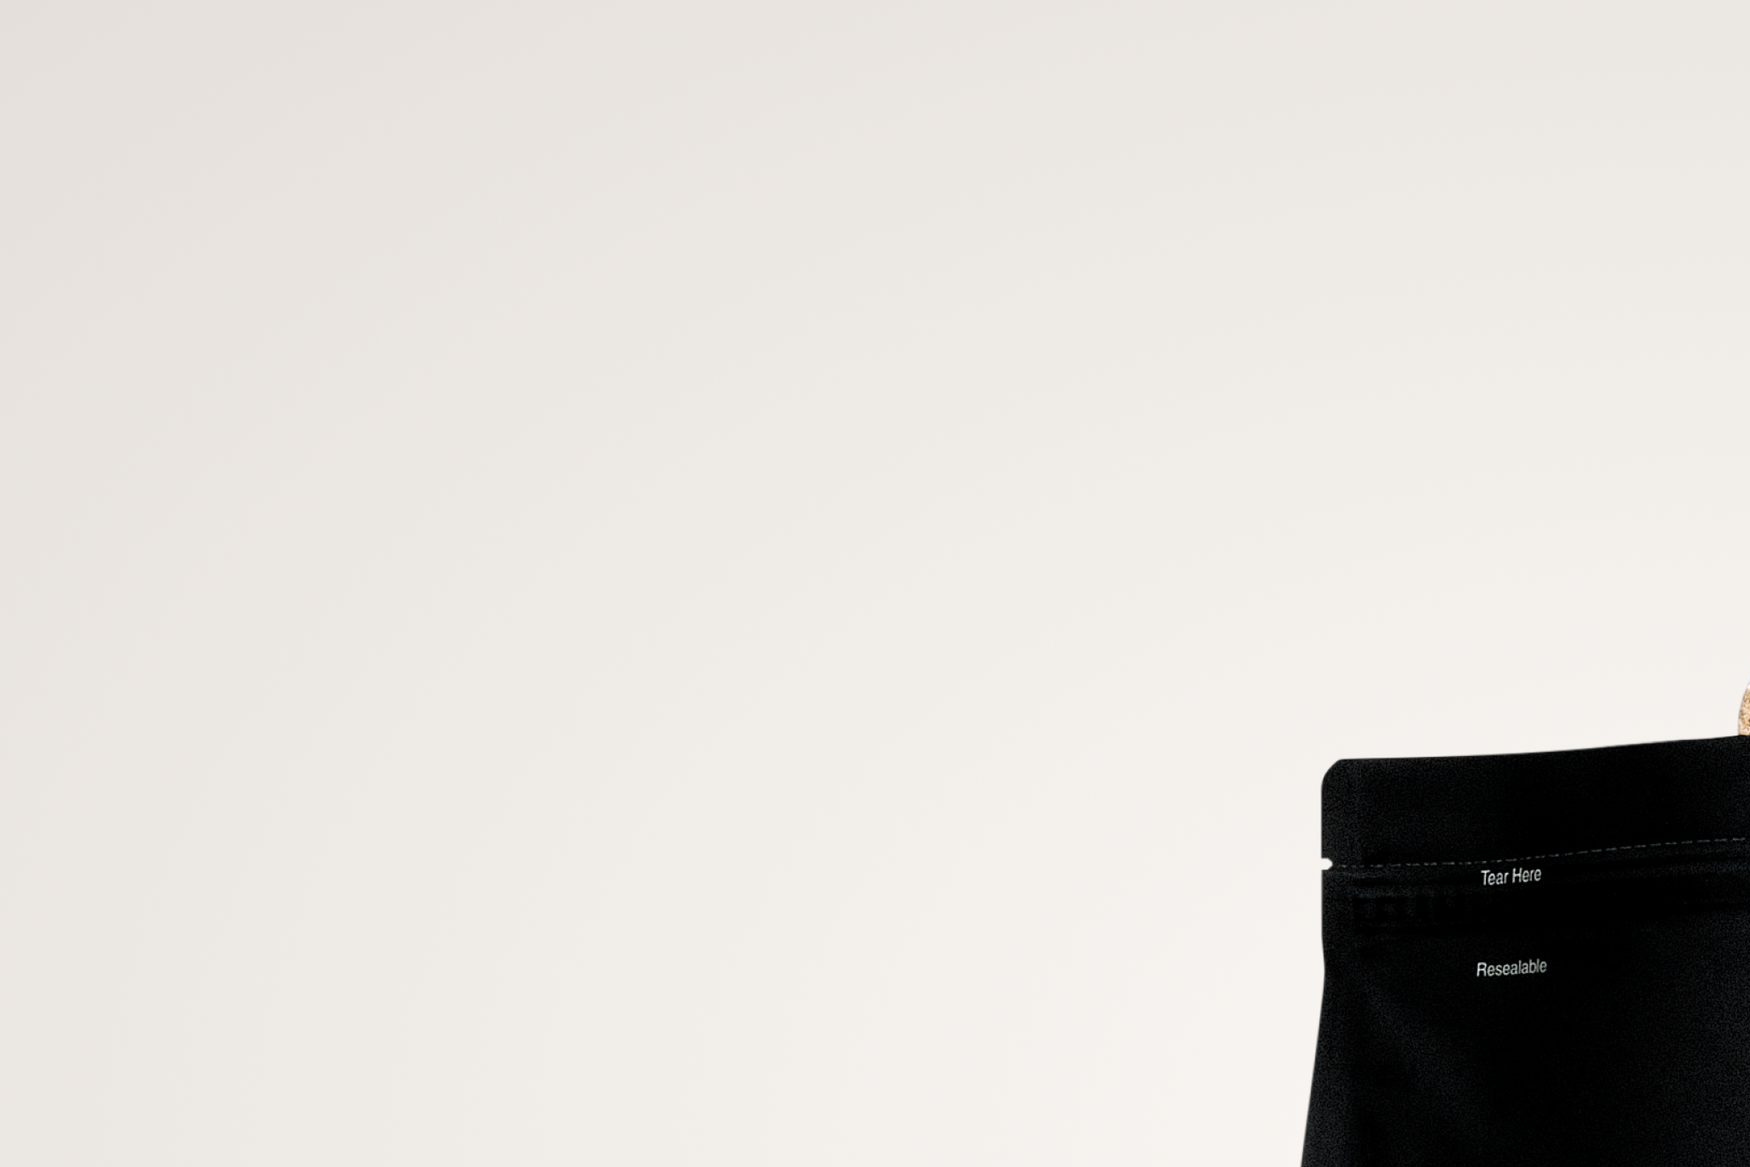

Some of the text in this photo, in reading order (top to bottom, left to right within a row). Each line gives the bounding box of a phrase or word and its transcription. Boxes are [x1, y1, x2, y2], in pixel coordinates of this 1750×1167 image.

[1481, 867, 1542, 886] Tear Here
[1476, 958, 1548, 977] Resealable
